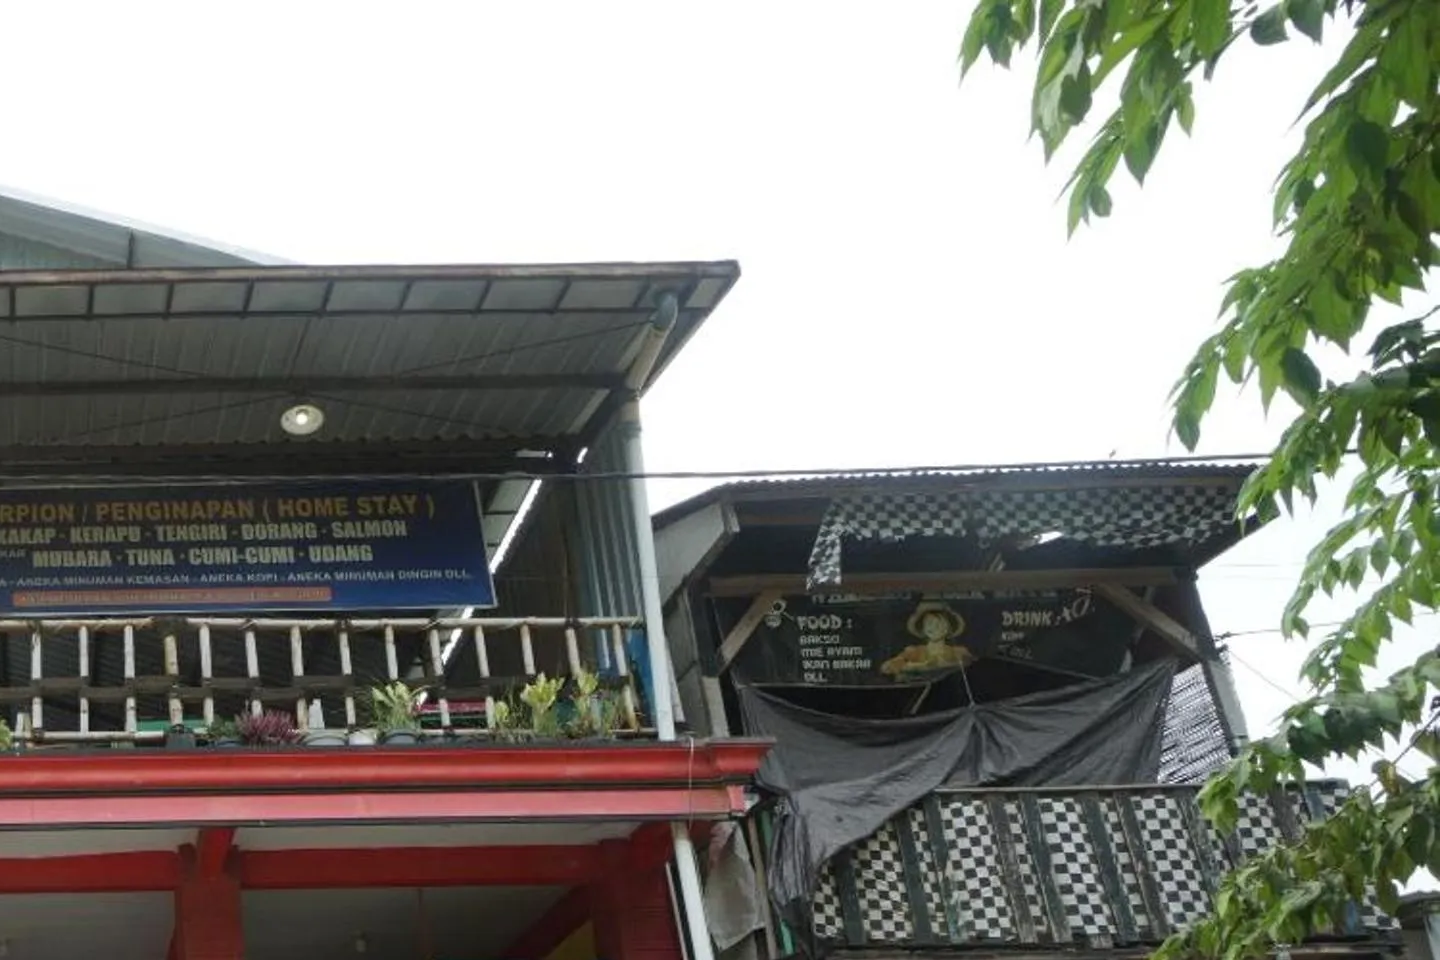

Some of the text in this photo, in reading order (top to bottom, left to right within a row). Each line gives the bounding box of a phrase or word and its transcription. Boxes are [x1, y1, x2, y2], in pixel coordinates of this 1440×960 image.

[96, 501, 253, 522] PENGINAPAN
[278, 498, 349, 518] HOME
[357, 495, 418, 516] STAY
[71, 525, 140, 544] KERAPU
[156, 522, 227, 542] TENGIRI
[332, 519, 407, 538] SALMON
[33, 544, 373, 568] MUBARA TUNA CUMI-CUMI UDANG
[126, 574, 190, 585] KEMASAN
[200, 573, 243, 583] ANEKA
[249, 572, 278, 583] KOPI
[287, 571, 331, 582] ANEKA
[797, 615, 841, 630] FOOD
[1002, 611, 1053, 626] DRINK
